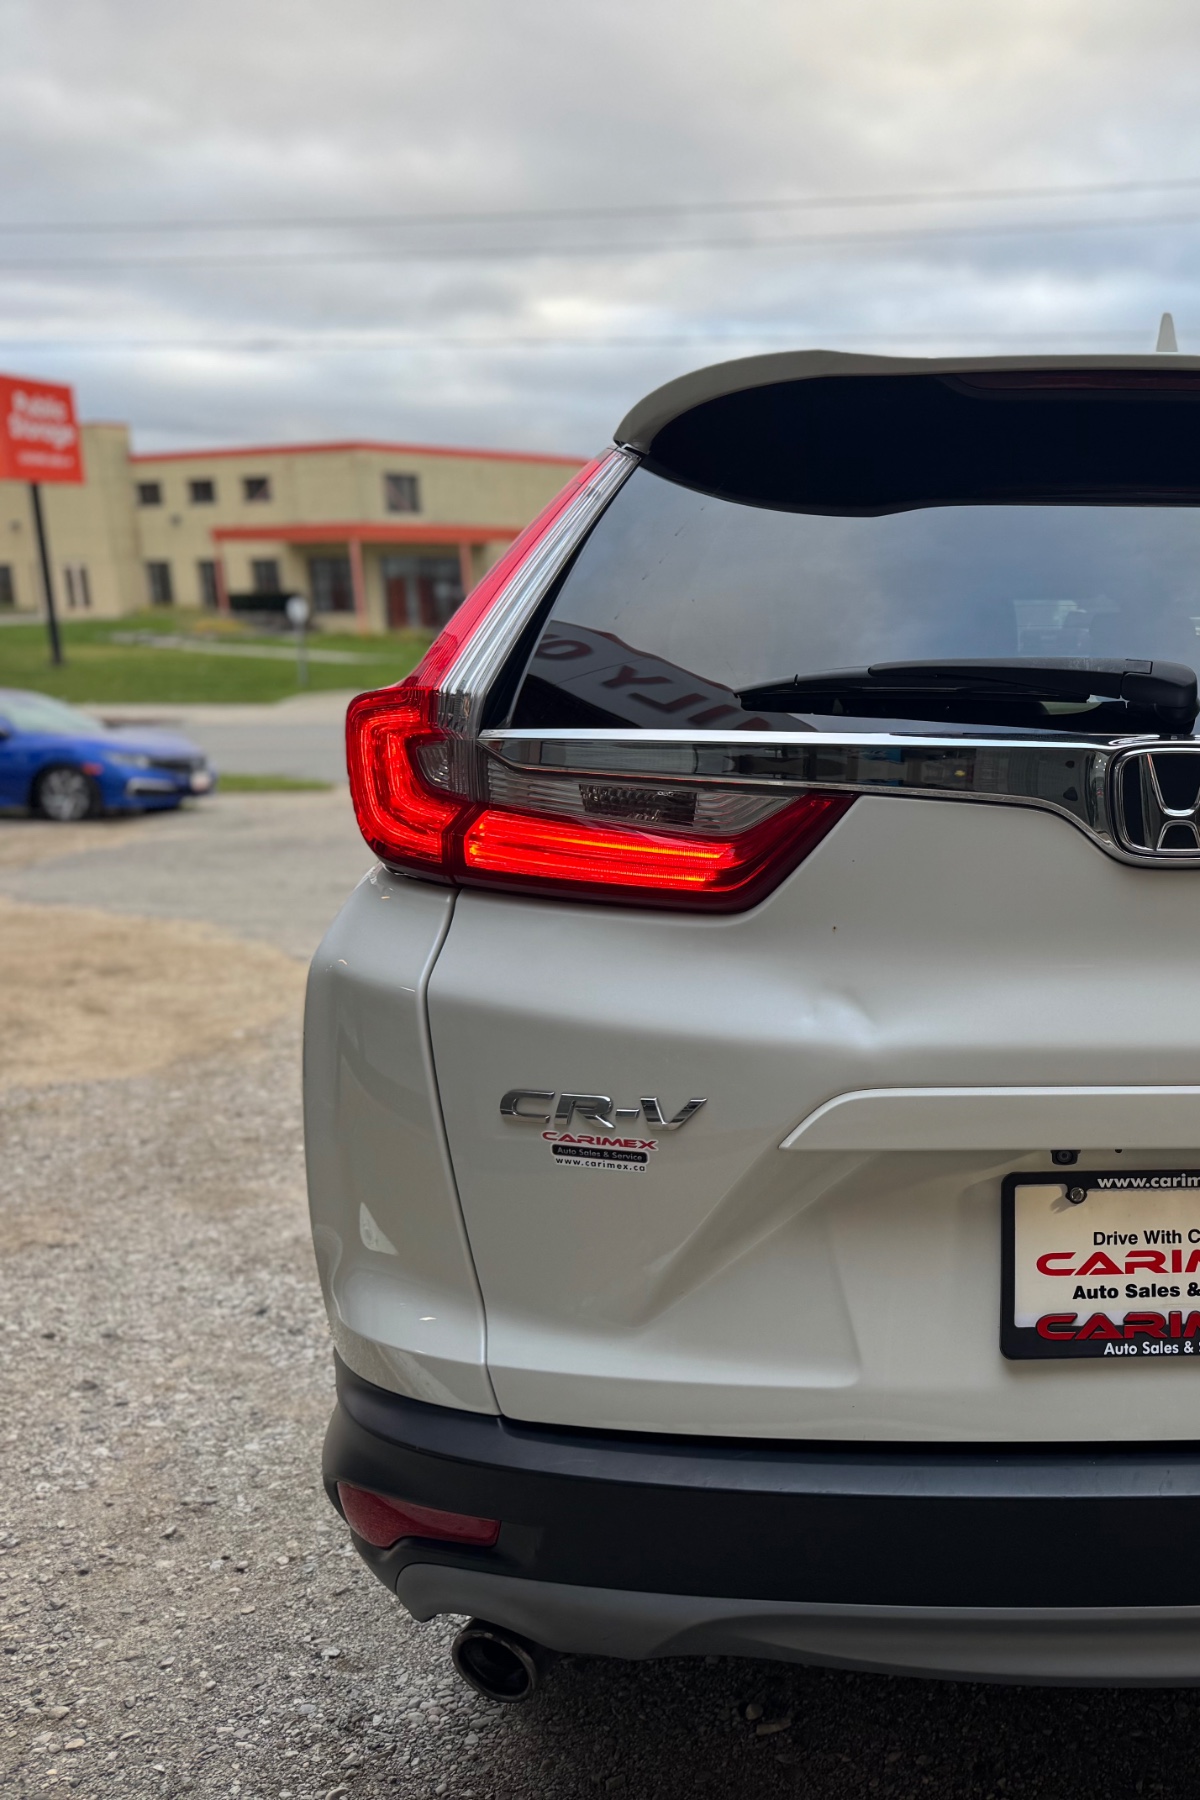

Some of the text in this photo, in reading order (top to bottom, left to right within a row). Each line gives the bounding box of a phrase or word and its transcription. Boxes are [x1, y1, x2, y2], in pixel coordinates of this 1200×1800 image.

[499, 1088, 708, 1132] CR-V
[542, 1131, 658, 1150] CARIMEX
[557, 1146, 577, 1156] Auto
[579, 1148, 601, 1158] Sales
[612, 1151, 643, 1161] Service
[555, 1157, 646, 1173] www.carimex.ca
[1093, 1231, 1138, 1246] Drive
[1143, 1229, 1182, 1245] With
[1072, 1285, 1119, 1300] Auto
[1125, 1283, 1181, 1298] Sales
[1103, 1342, 1138, 1355] Auto
[1142, 1340, 1179, 1354] Sales
[1183, 1340, 1194, 1353] &
